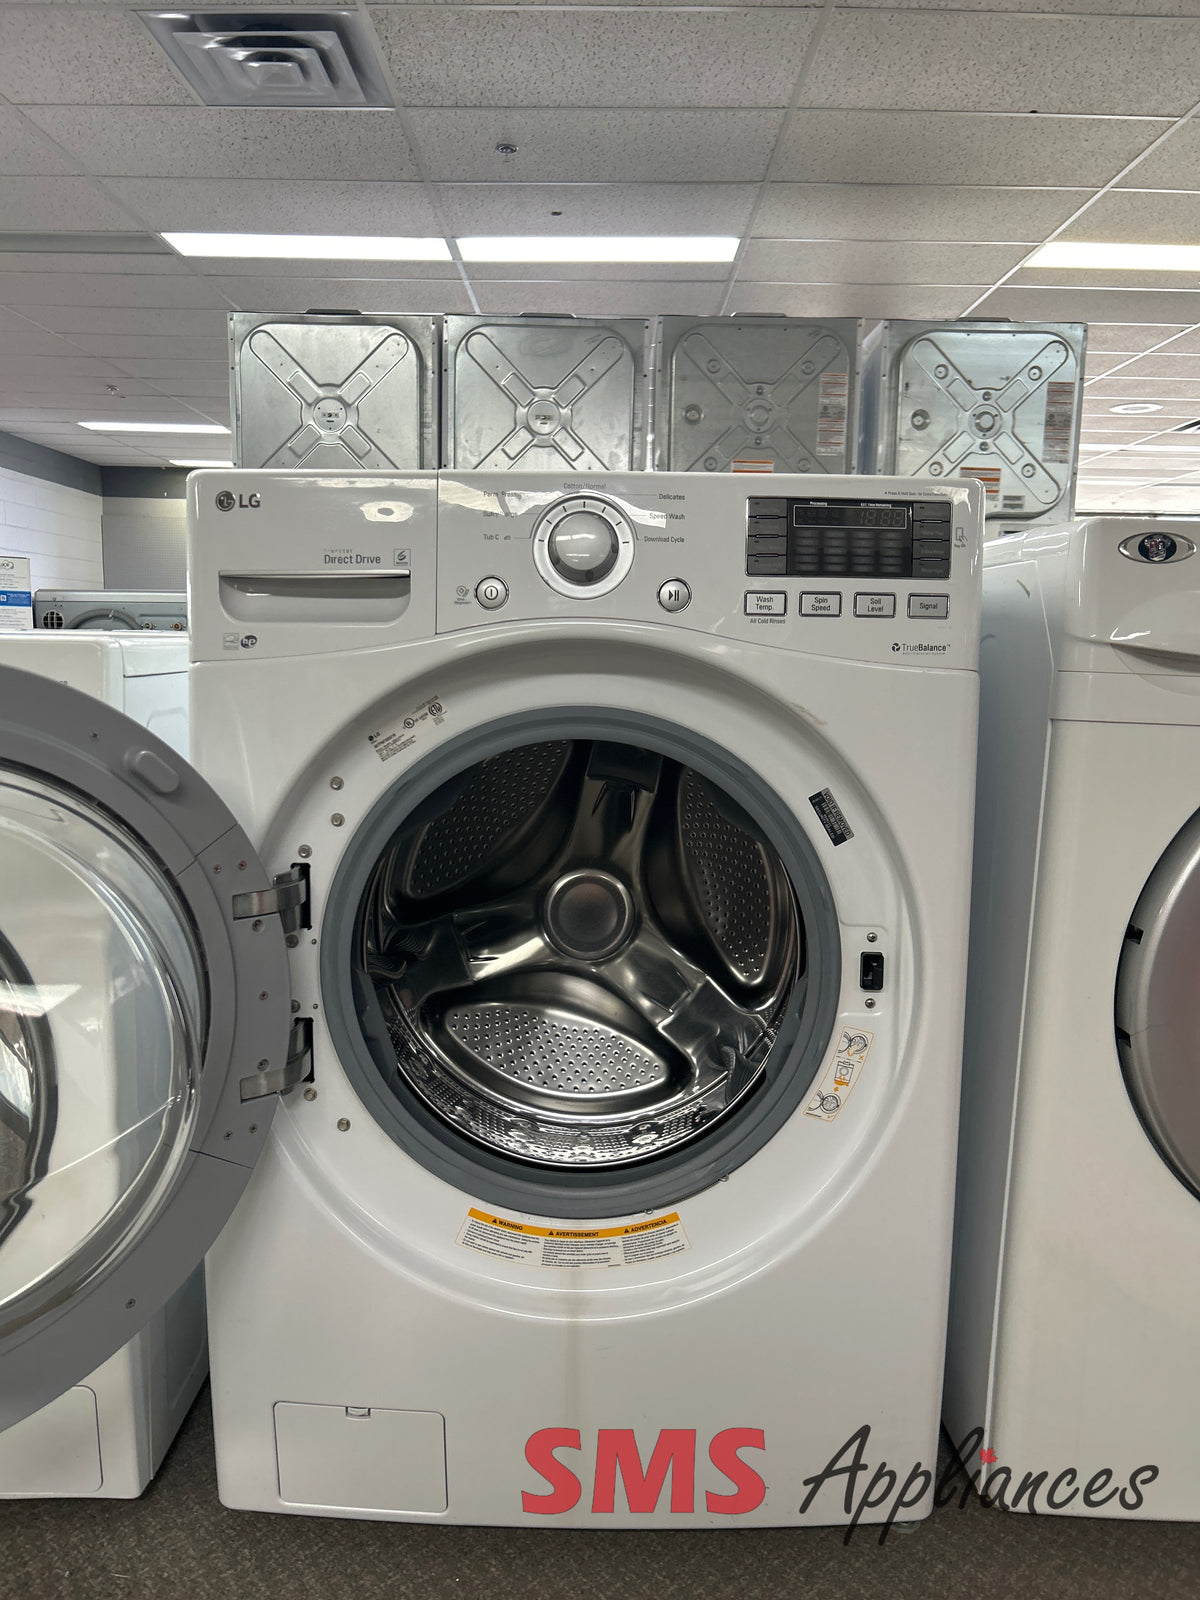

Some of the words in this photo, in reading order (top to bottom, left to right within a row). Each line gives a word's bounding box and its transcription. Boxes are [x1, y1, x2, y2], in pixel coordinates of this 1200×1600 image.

[239, 493, 261, 508] LG
[324, 554, 353, 564] Direct
[355, 554, 381, 564] Drive
[755, 595, 774, 603] Wash
[811, 604, 831, 612] Speed
[919, 603, 938, 611] Signal
[823, 792, 834, 805] VOID
[833, 810, 851, 836] REMOVED
[498, 1219, 523, 1231] WARNING
[631, 1219, 668, 1232] ADVERTENCIA
